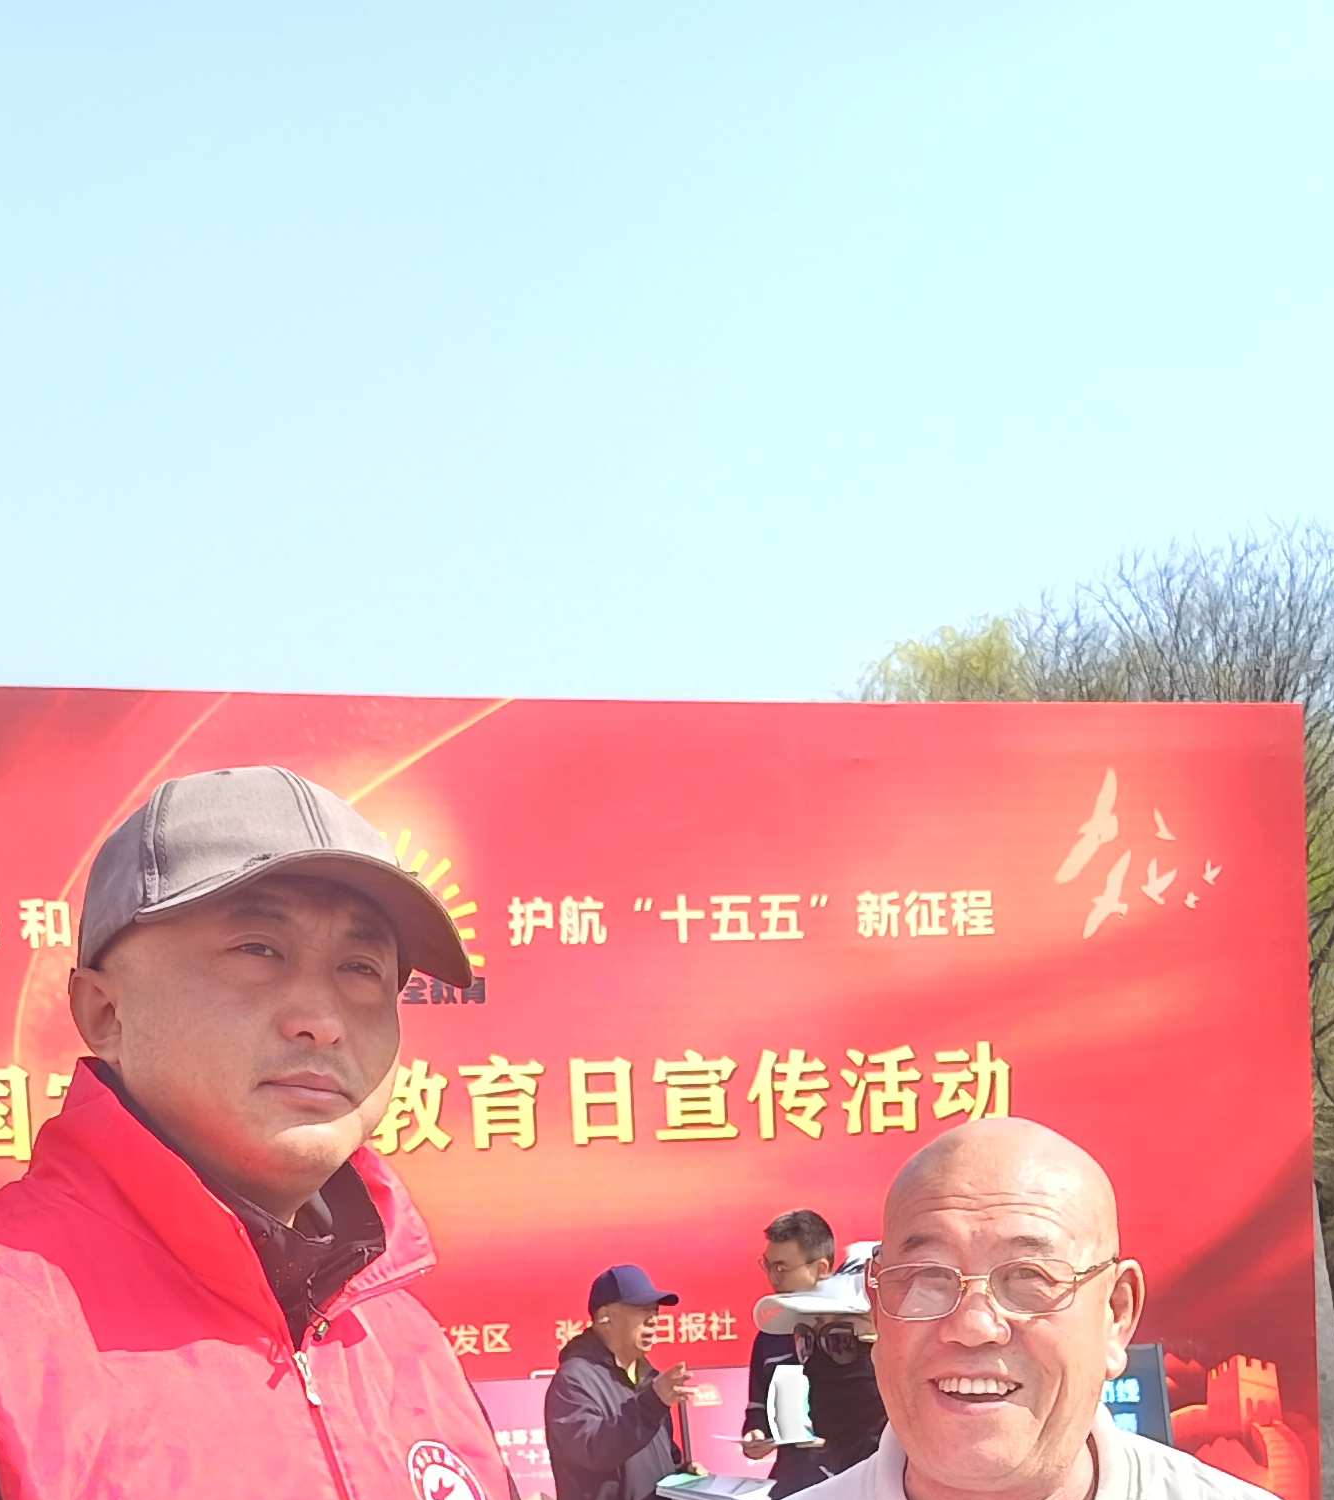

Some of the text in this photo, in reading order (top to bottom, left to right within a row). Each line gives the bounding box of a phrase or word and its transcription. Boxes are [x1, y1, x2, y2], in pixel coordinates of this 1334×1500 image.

[370, 1041, 1013, 1155] 教育日宣传活动
[441, 1322, 512, 1356] 发区
